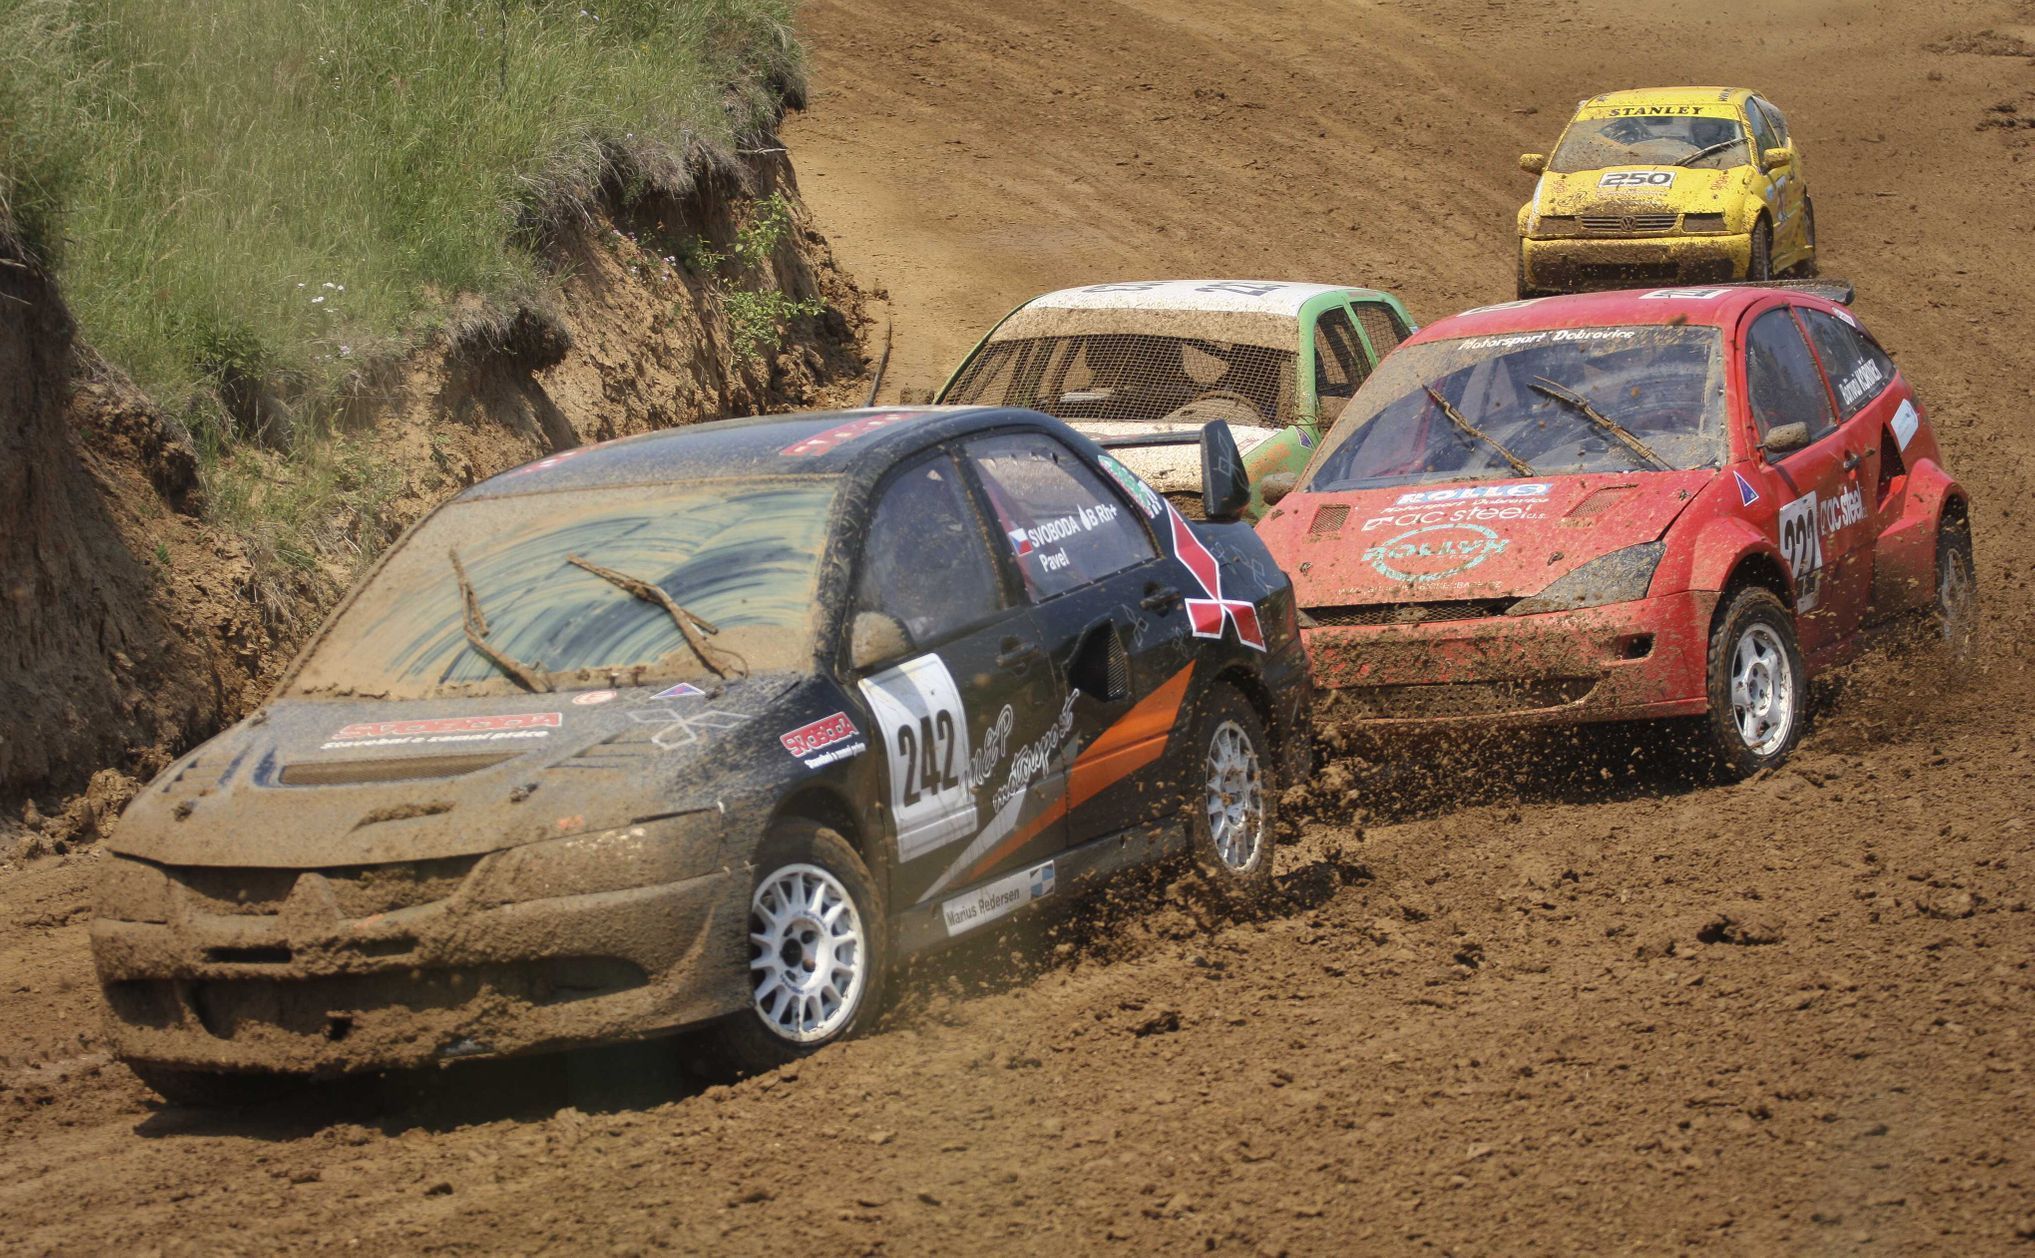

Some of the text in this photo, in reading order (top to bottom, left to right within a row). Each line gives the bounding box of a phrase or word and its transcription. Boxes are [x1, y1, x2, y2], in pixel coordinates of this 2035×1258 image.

[1609, 106, 1704, 117] STANLEY
[1601, 172, 1672, 186] 250
[1459, 329, 1635, 350] Motorsport Dobrovice
[1028, 503, 1118, 548] SVOBODA B Rh+
[1395, 510, 1444, 527] ac
[1039, 547, 1071, 573] Pavel
[898, 709, 958, 808] 242
